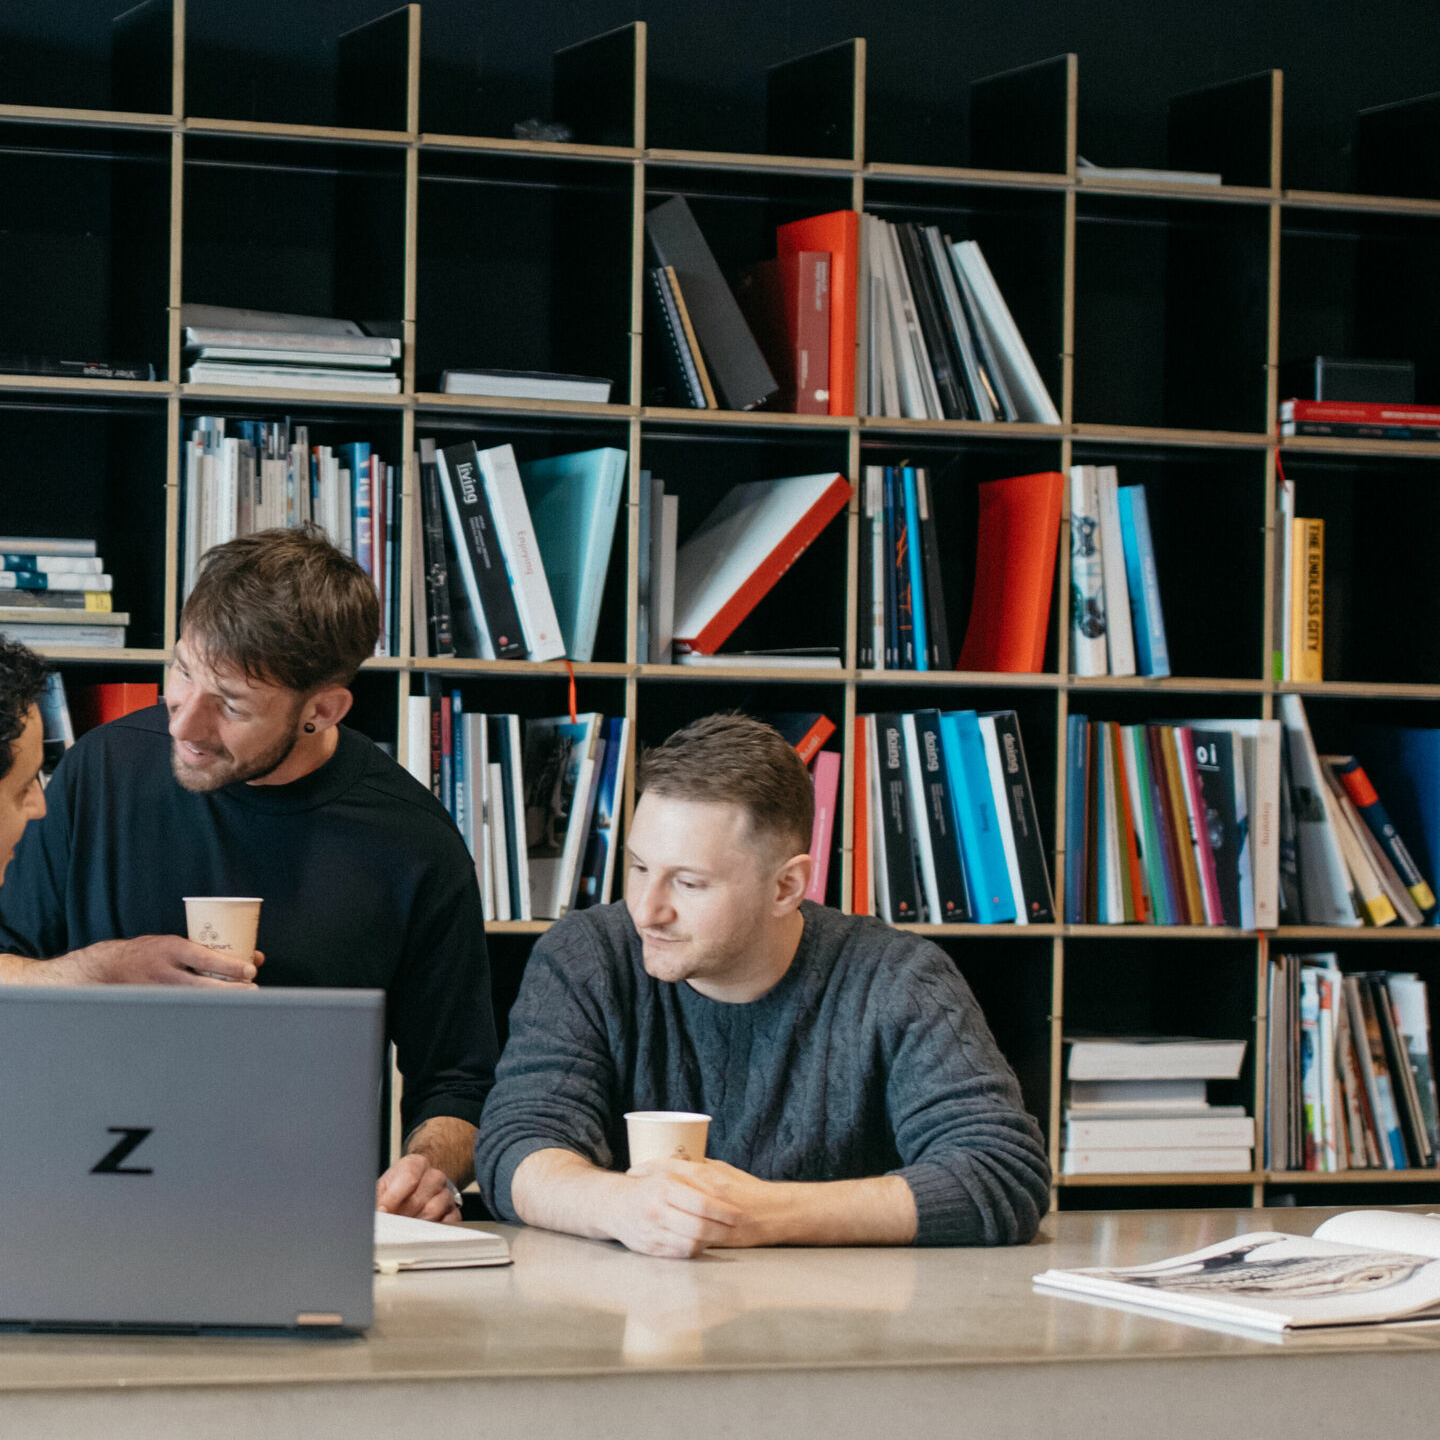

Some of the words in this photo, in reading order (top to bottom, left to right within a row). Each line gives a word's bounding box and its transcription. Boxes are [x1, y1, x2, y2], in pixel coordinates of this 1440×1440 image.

[456, 462, 478, 505] living
[1308, 525, 1320, 548] THE
[1308, 554, 1320, 616] ENDLESS
[1307, 620, 1320, 650] CITY
[886, 727, 900, 769] doing
[923, 730, 939, 772] doing
[1002, 732, 1019, 774] doing
[89, 1127, 154, 1175] Z
